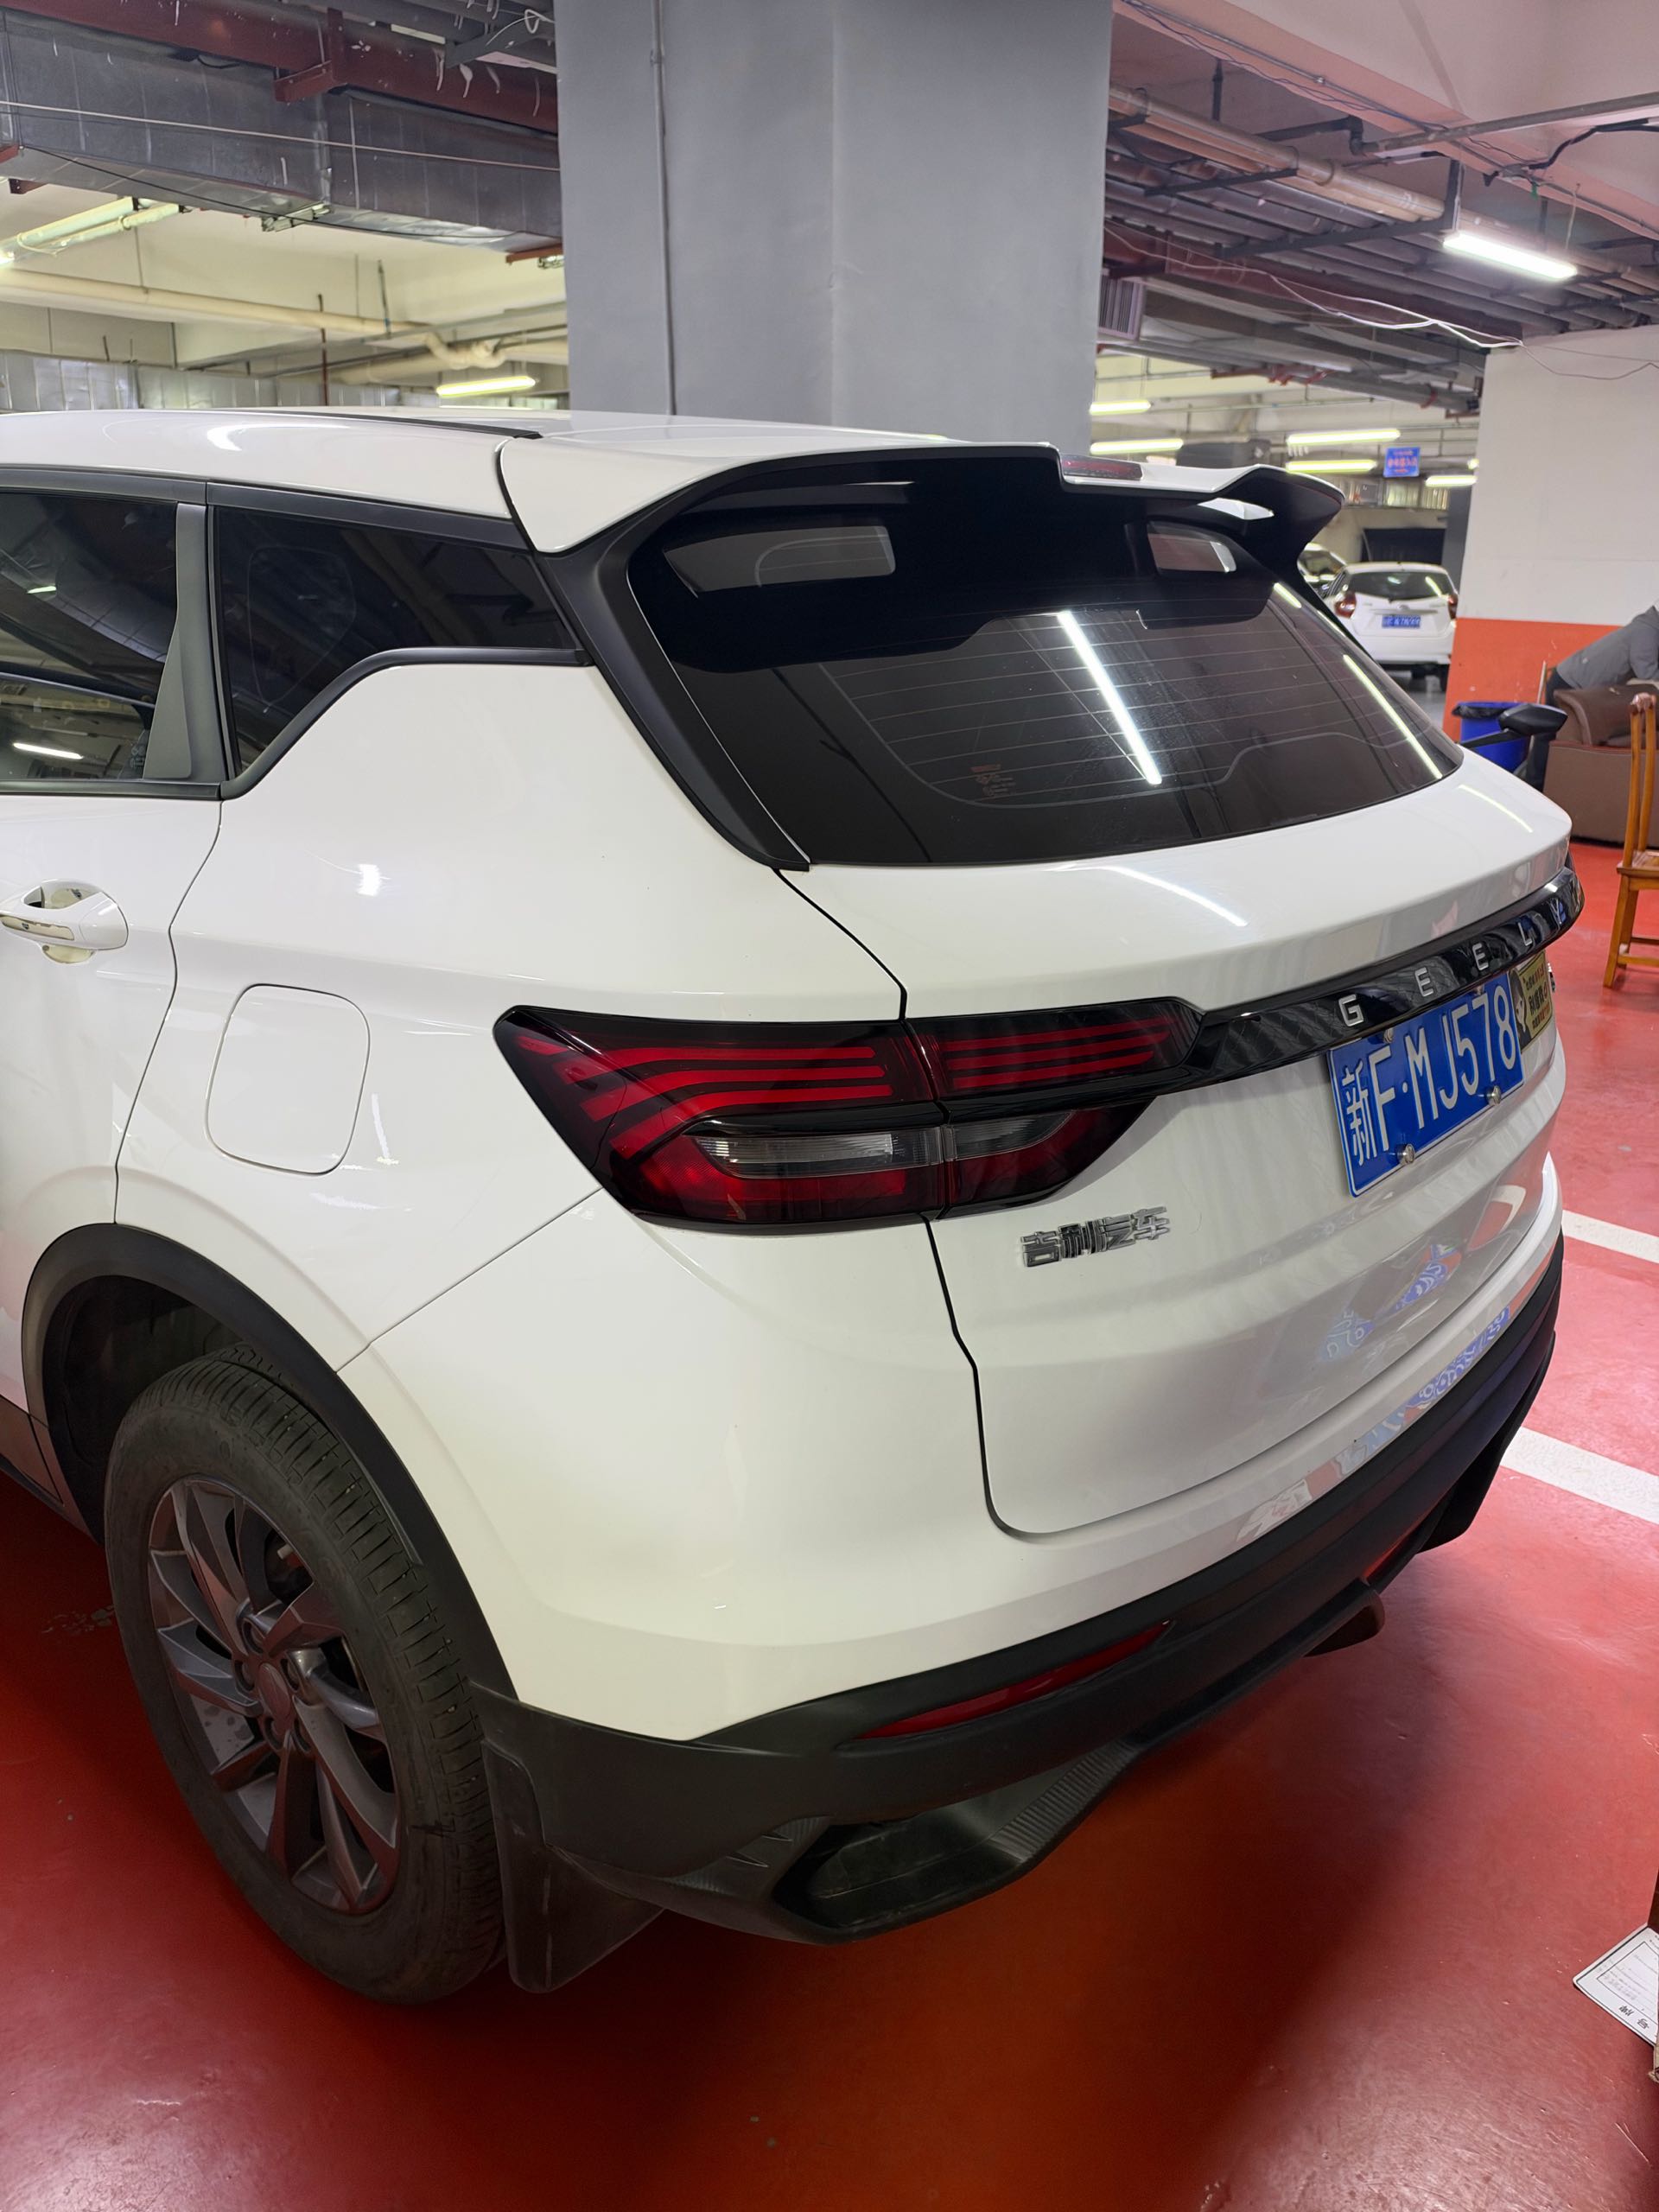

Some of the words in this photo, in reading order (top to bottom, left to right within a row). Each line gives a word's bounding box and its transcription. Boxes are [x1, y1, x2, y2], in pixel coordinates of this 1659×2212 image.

[1338, 898, 1564, 1027] GEELY
[1020, 1206, 1171, 1268] 吉利汽车
